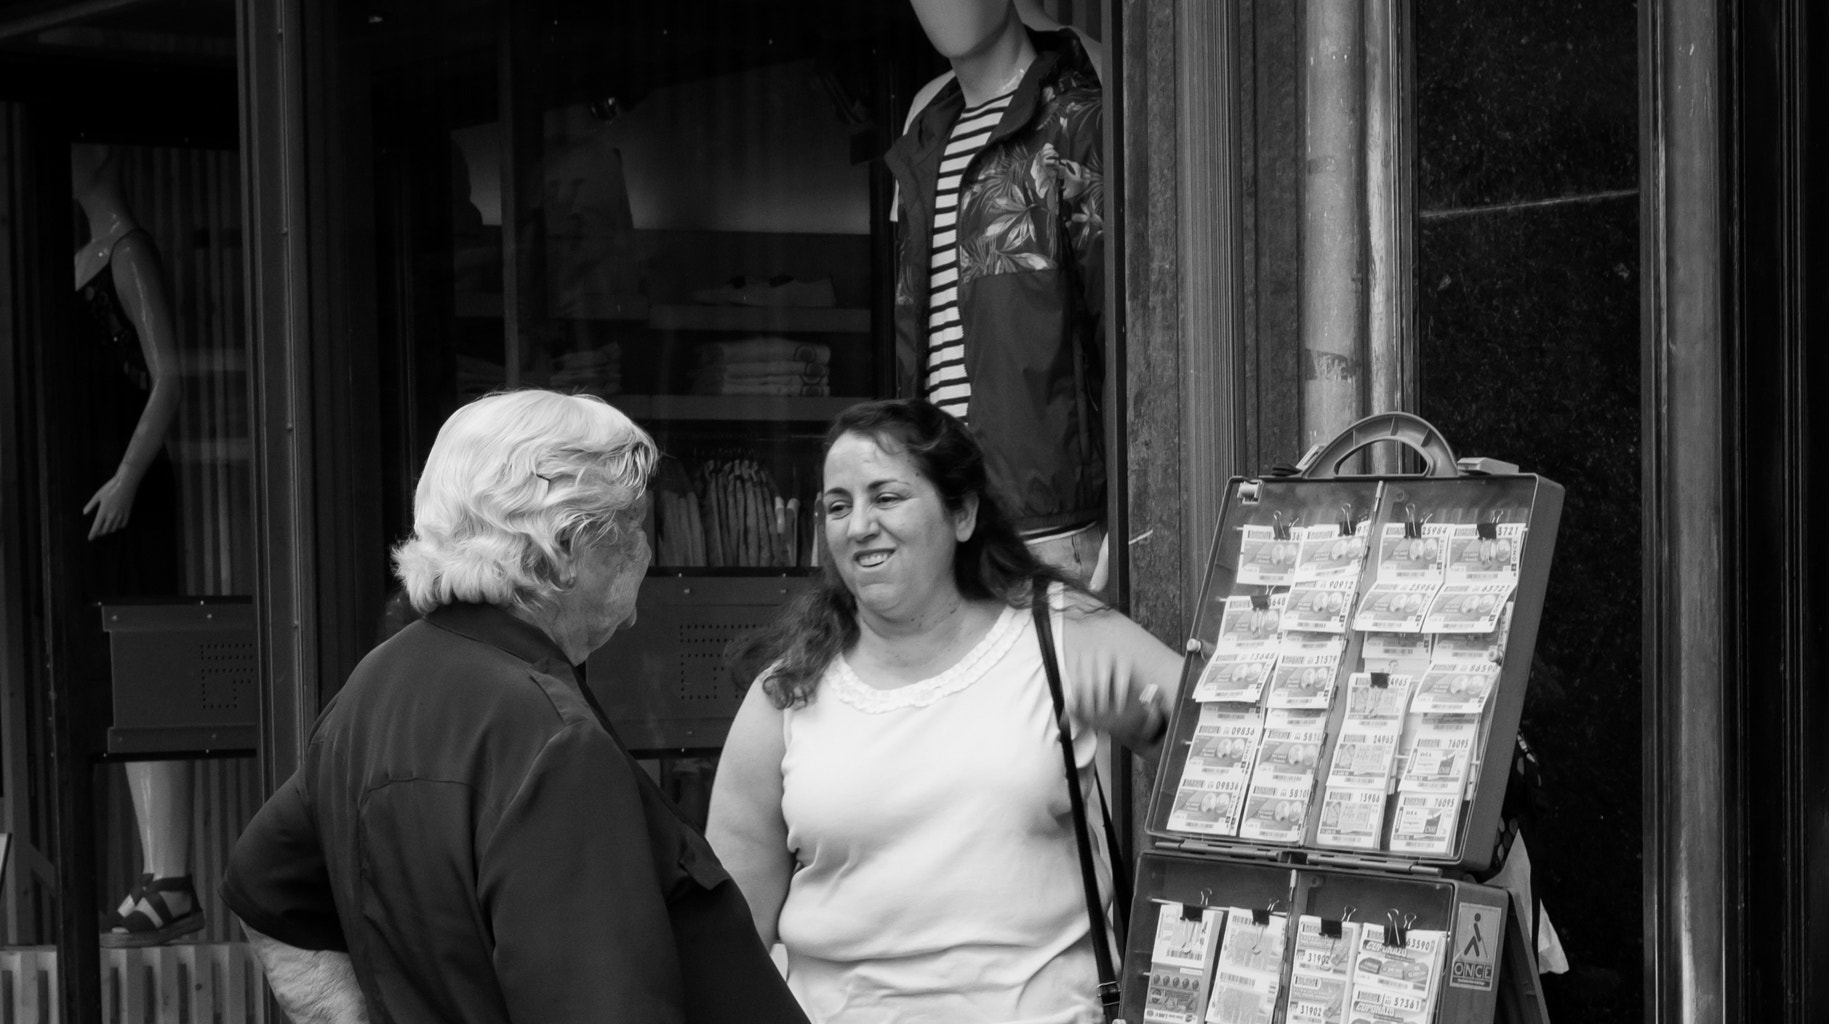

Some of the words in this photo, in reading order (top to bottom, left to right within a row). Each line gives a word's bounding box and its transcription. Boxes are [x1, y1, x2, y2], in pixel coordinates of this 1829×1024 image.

[1422, 526, 1447, 536] 25984
[1497, 526, 1519, 536] 3721
[1330, 580, 1353, 590] 90912
[1469, 664, 1498, 673] 86590
[1231, 727, 1255, 736] 09836
[1373, 735, 1394, 744] 24965
[1448, 739, 1469, 748] 76095
[1215, 781, 1239, 791] 09836
[1360, 793, 1380, 803] 15986
[1434, 798, 1455, 808] 76095
[1406, 938, 1430, 951] 63590
[1454, 962, 1492, 979] ONCE
[1394, 997, 1420, 1010] 57361
[1300, 1005, 1322, 1017] 31902
